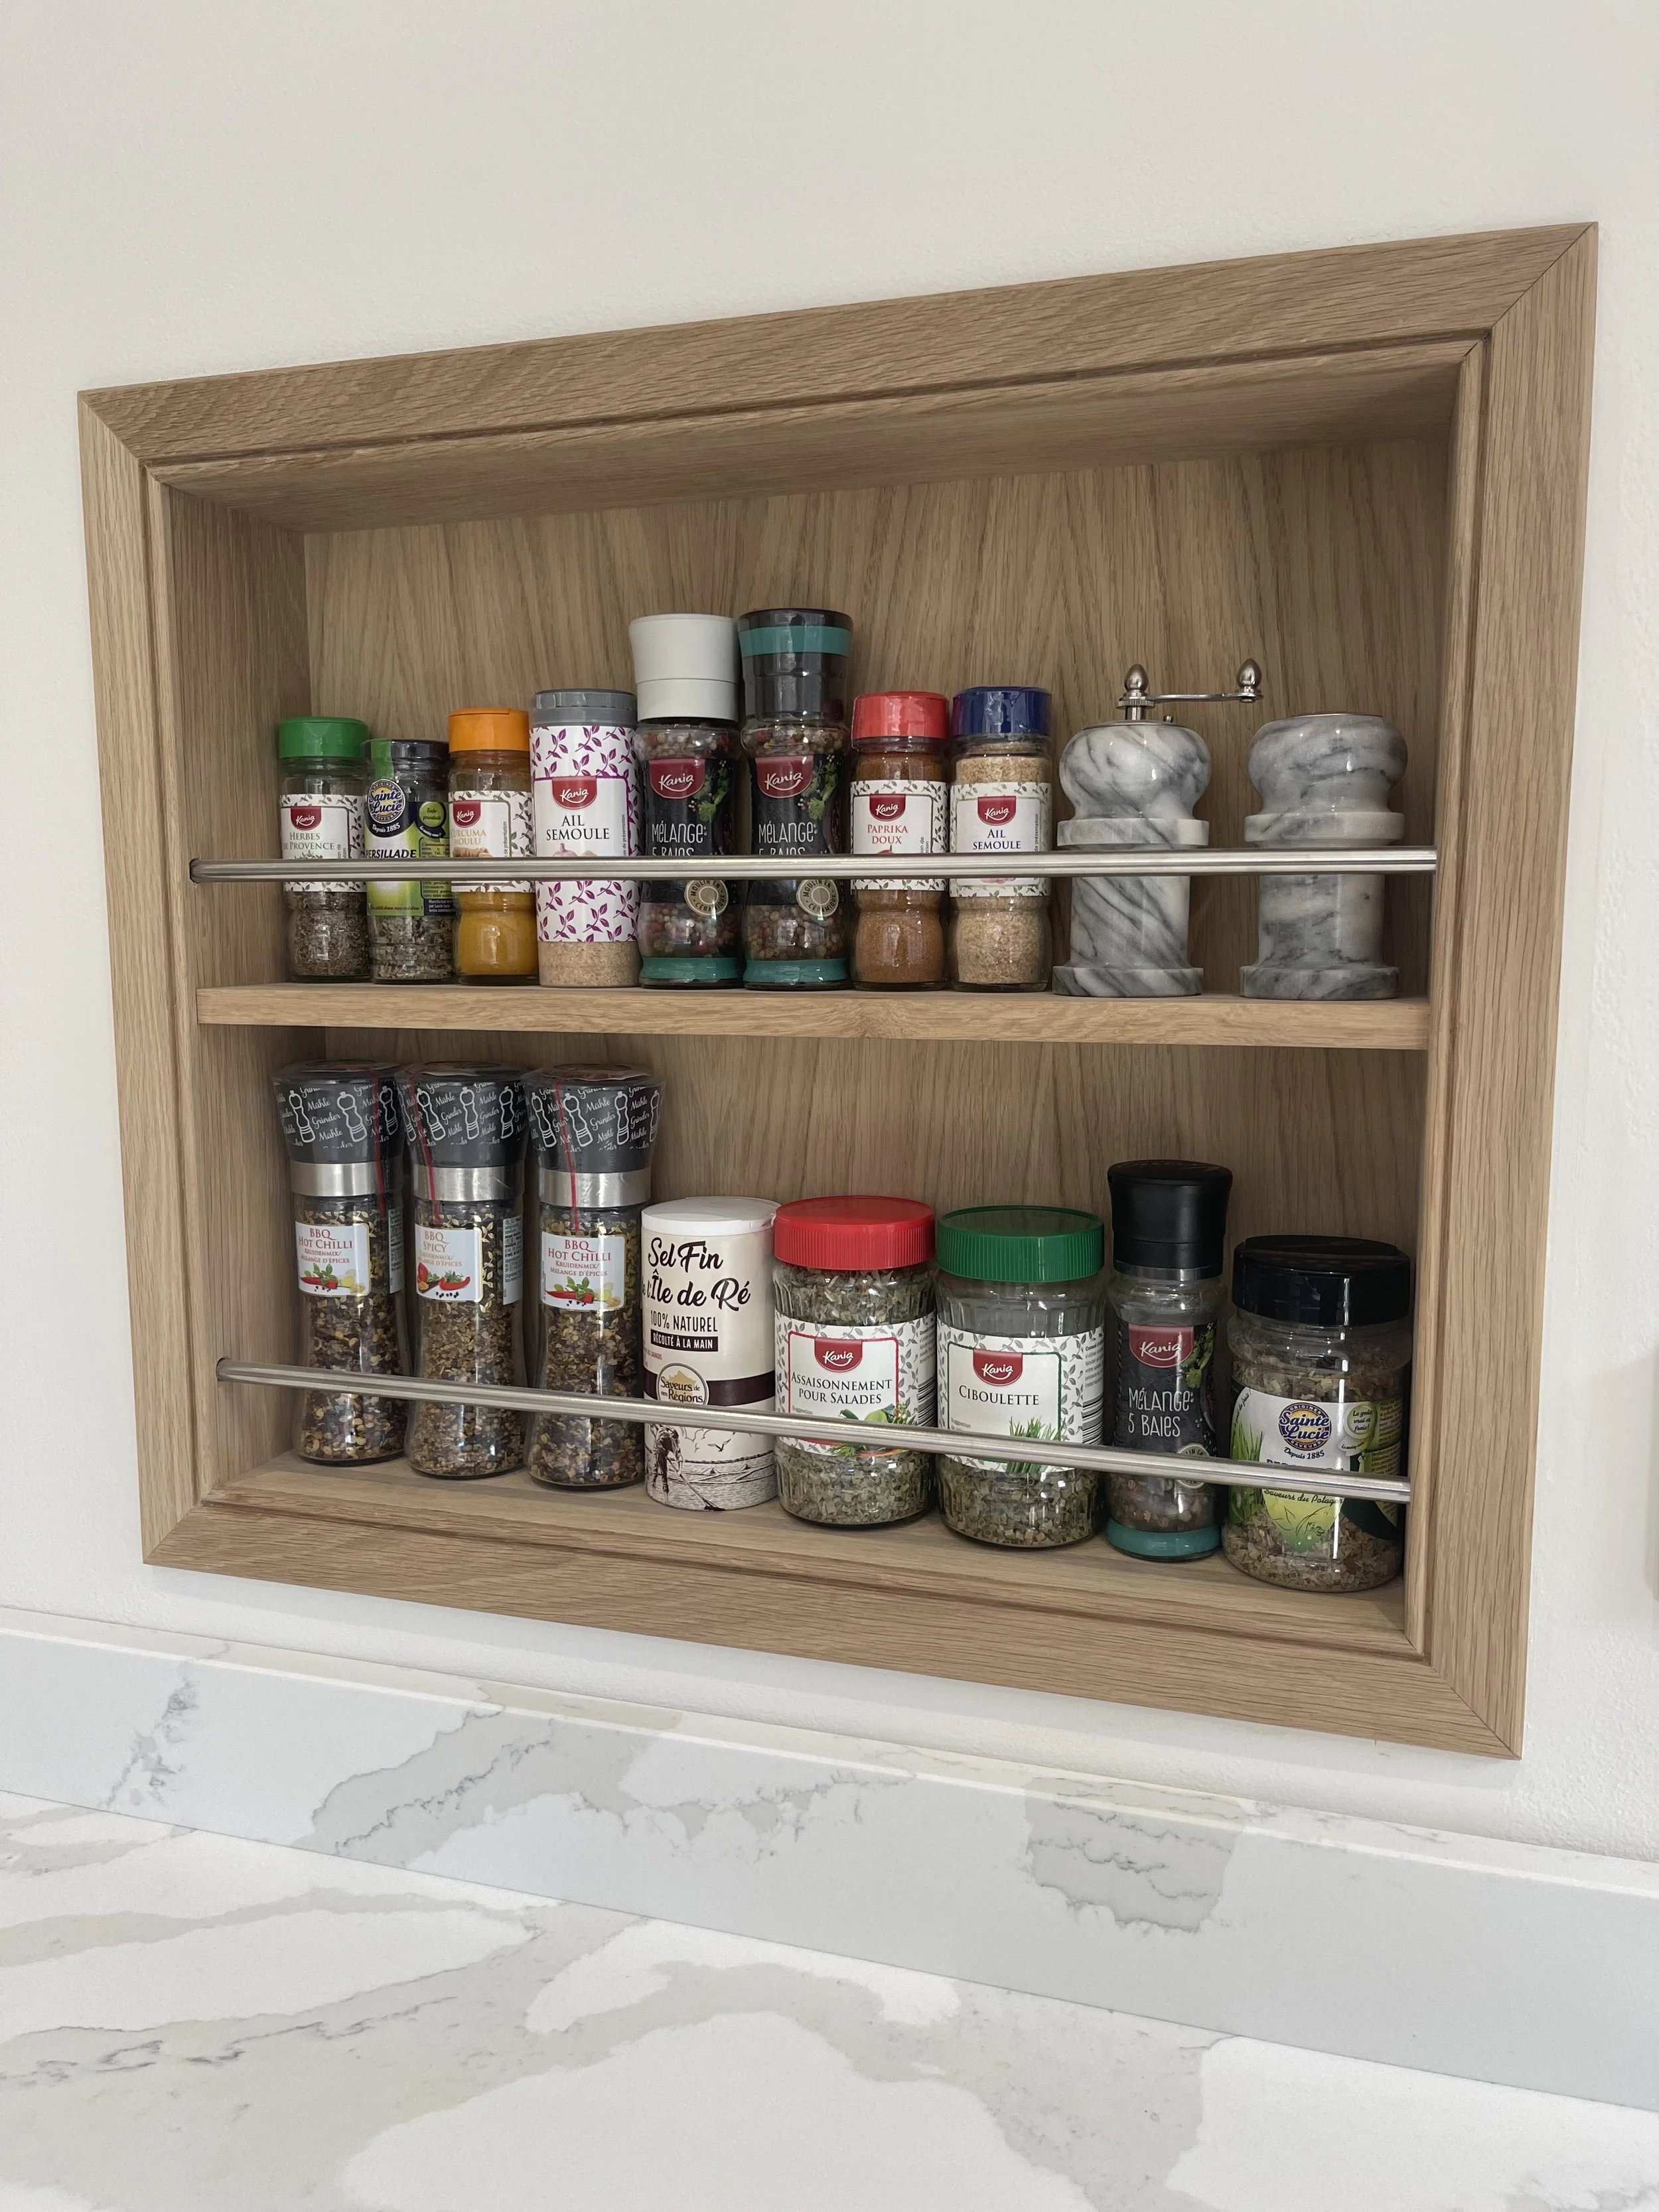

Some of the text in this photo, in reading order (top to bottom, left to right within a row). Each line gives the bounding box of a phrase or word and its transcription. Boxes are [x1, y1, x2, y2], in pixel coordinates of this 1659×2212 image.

[659, 773, 694, 792] Kania
[764, 771, 804, 791] Kania
[369, 790, 401, 803] Sainte
[560, 788, 589, 804] Kania
[372, 800, 401, 814] Lucie
[875, 804, 899, 817] Kania
[985, 807, 1009, 821] Kania
[296, 815, 315, 826] Kania
[457, 810, 474, 823] Kania
[561, 815, 585, 827] AIL
[386, 823, 401, 832] 1885
[546, 828, 609, 841] SEMOULE
[867, 824, 908, 834] PAPRIKA
[987, 828, 1005, 838] AIL
[973, 840, 1021, 850] SEMOULE
[309, 1228, 338, 1240] BBQ
[425, 1230, 451, 1244] BBQ
[299, 1236, 352, 1249] HOT CHILLI
[423, 1241, 447, 1253] SPICY
[565, 1240, 596, 1253] BBQ
[548, 1248, 611, 1261] HOT CHILLI
[648, 1237, 724, 1273] Sel Fin
[678, 1281, 707, 1307] de
[711, 1278, 751, 1311] Ré
[650, 1310, 718, 1332] 100% NATUREL
[653, 1331, 713, 1349] RÉCOLTÉ À LA MAIN
[1139, 1341, 1181, 1361] Kania
[823, 1351, 854, 1367] Kania
[981, 1363, 1013, 1380] Kania
[661, 1376, 693, 1392] Saveurs
[791, 1371, 892, 1391] ASSAISONNEMENT
[669, 1388, 703, 1404] Régions
[799, 1388, 882, 1405] POUR SALADES
[959, 1385, 1039, 1406] CIBOULETTE
[1289, 1404, 1321, 1415] ORIGINES
[1128, 1413, 1134, 1434] 5
[1279, 1411, 1329, 1427] Sainte
[1283, 1426, 1329, 1441] Lucie
[1290, 1440, 1321, 1449] SAVEURS
[1284, 1447, 1325, 1459] Depuis 1885
[1263, 1489, 1295, 1501] Saveurs
[1297, 1493, 1309, 1502] du
